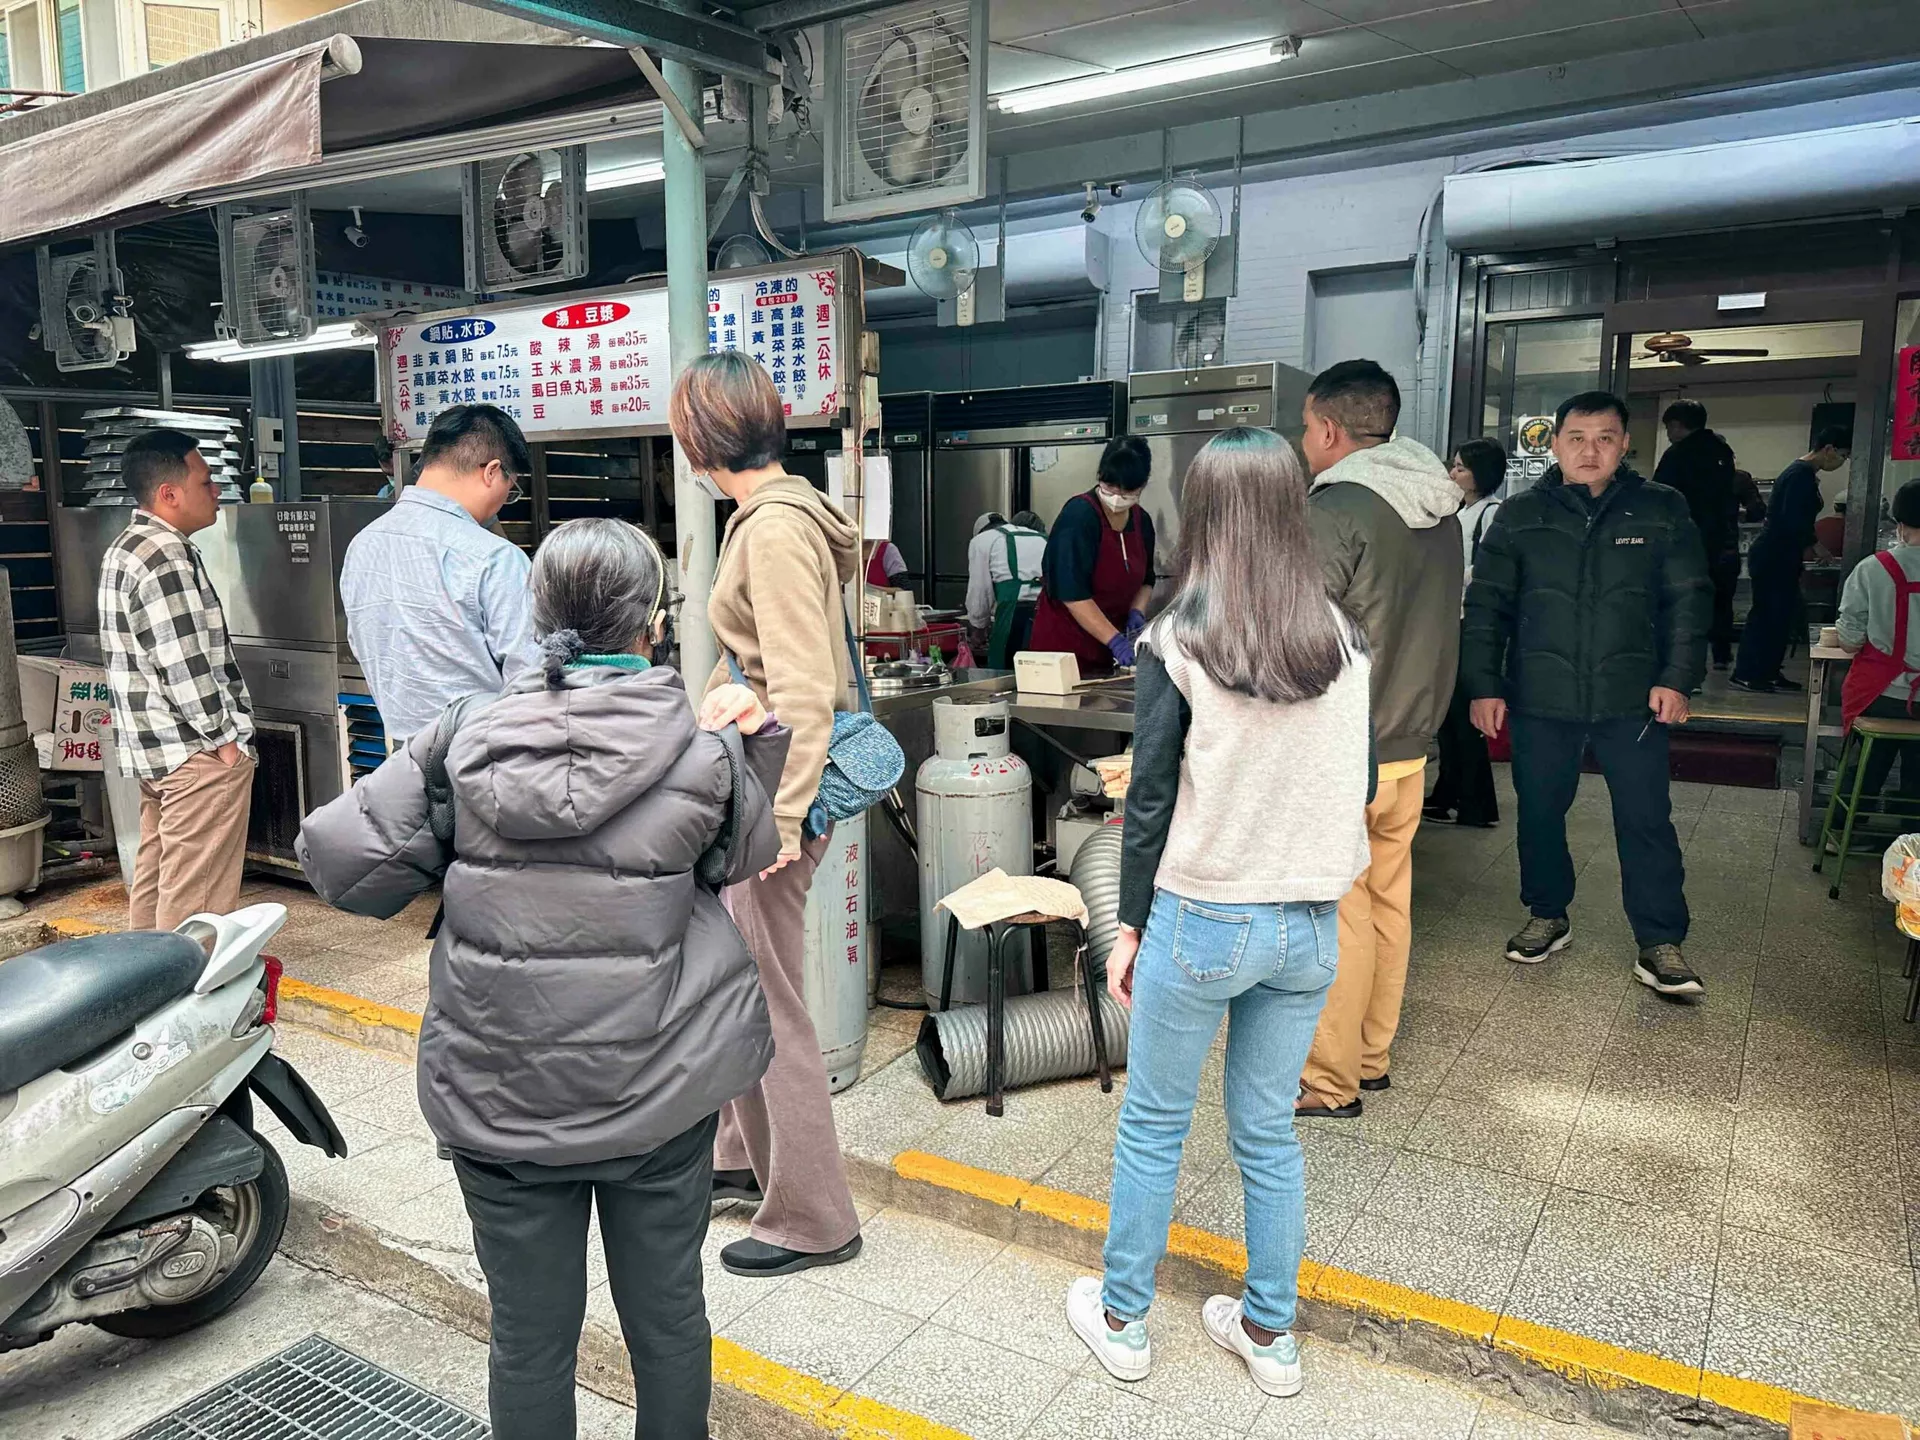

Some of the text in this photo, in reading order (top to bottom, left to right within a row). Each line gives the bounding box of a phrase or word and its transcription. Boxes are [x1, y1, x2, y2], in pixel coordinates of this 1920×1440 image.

[755, 277, 798, 296] 冷凍的
[529, 333, 601, 356] 酸辣湯
[771, 308, 786, 384] 高麗菜水餃
[790, 305, 806, 382] 綠韭菜水餃
[816, 304, 831, 380] 週二公休
[413, 347, 473, 368] 韭黃鍋貼
[531, 355, 602, 377] 玉米濃湯
[397, 355, 411, 412] 週二公休
[413, 368, 475, 387] 高麗菜水餃
[531, 377, 602, 399] 虱目魚丸湯
[611, 396, 651, 413] 每杯20元
[845, 843, 859, 965] 液化石油氣
[169, 1255, 204, 1274] SYM
